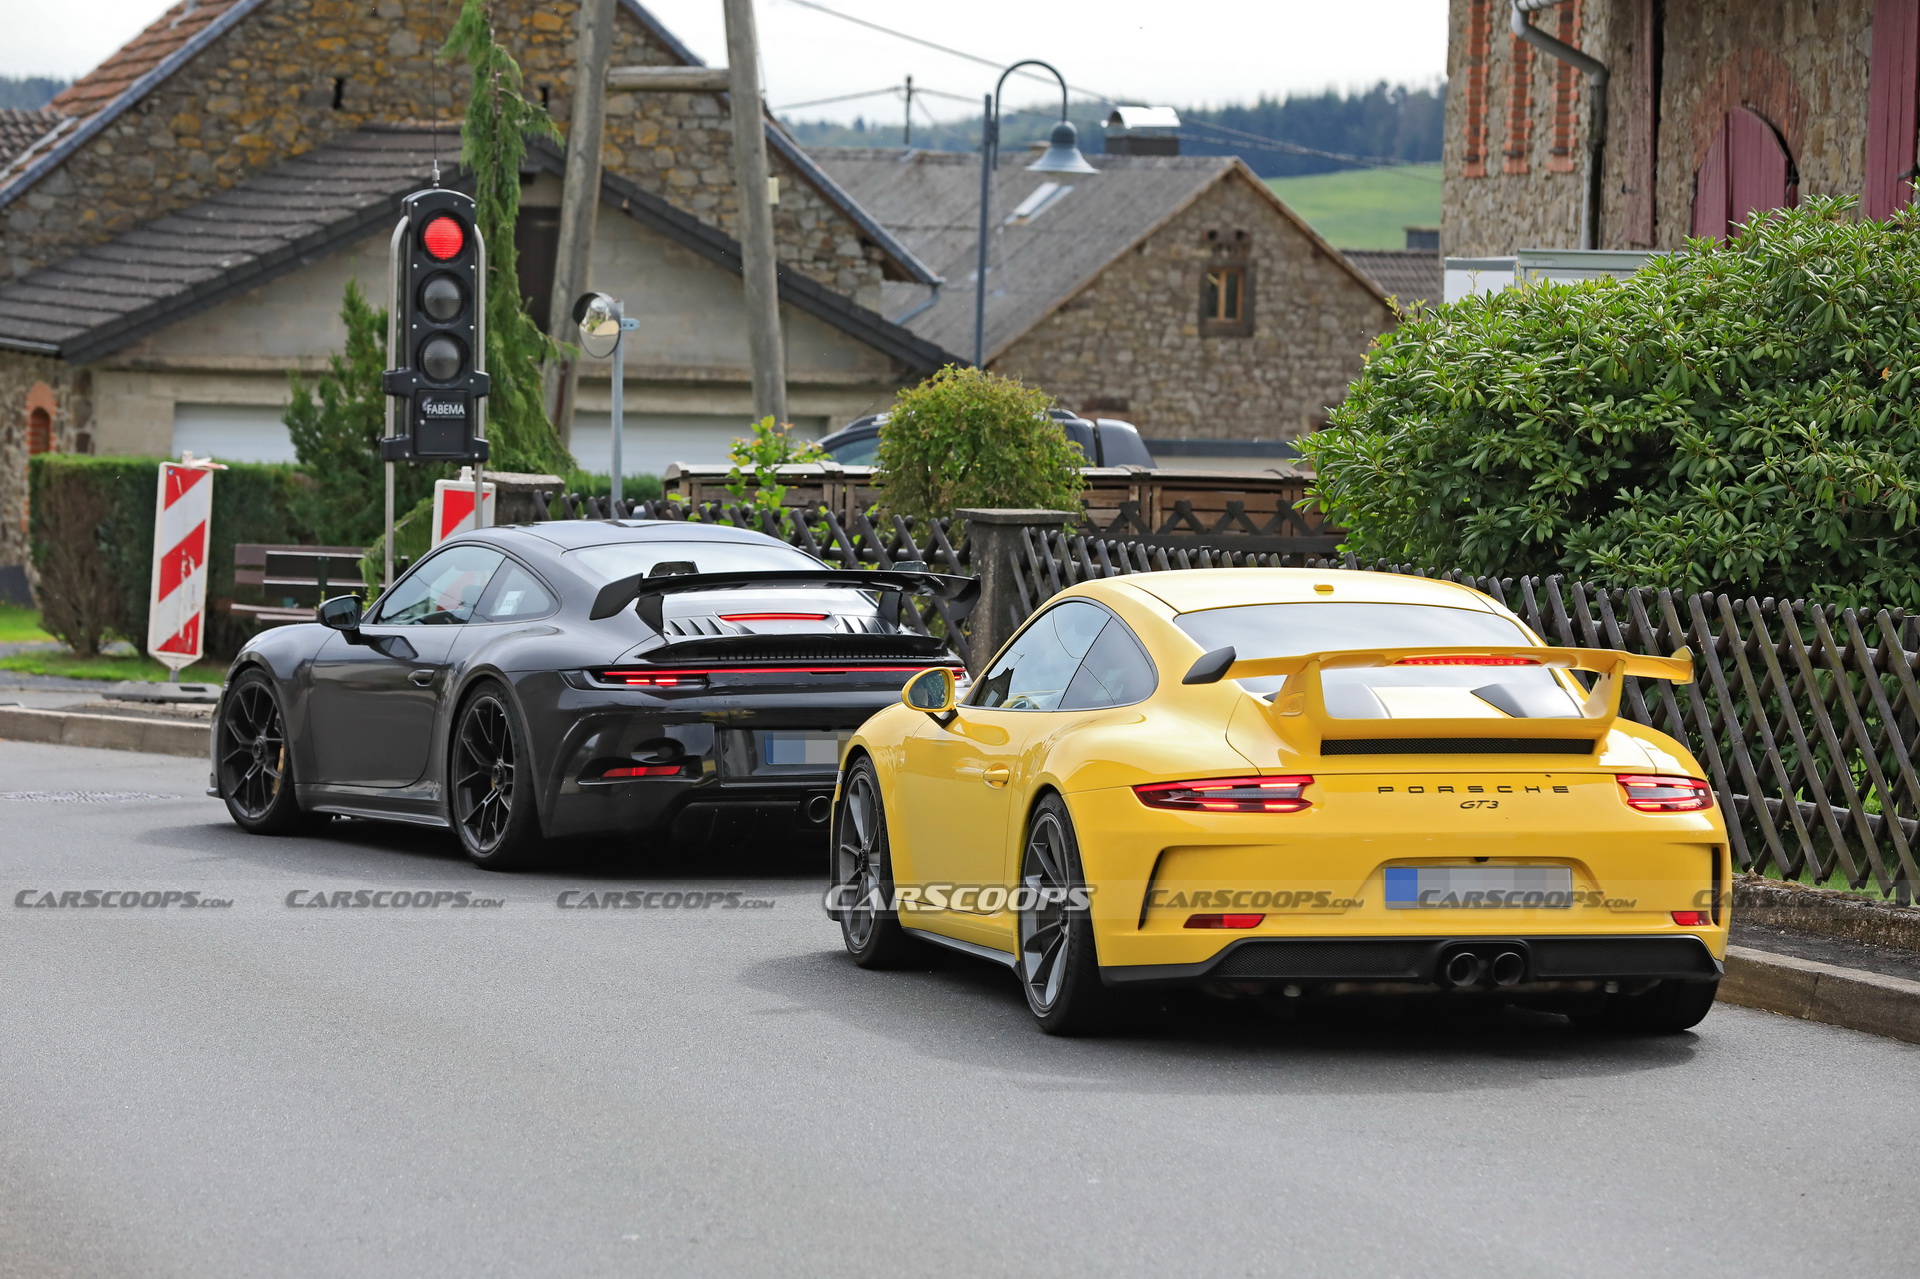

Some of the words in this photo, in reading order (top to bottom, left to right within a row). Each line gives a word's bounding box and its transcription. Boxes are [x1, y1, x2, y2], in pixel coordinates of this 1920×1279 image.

[426, 403, 466, 415] FABEMA
[1377, 785, 1570, 794] PORSCHE
[1459, 799, 1500, 810] GT3
